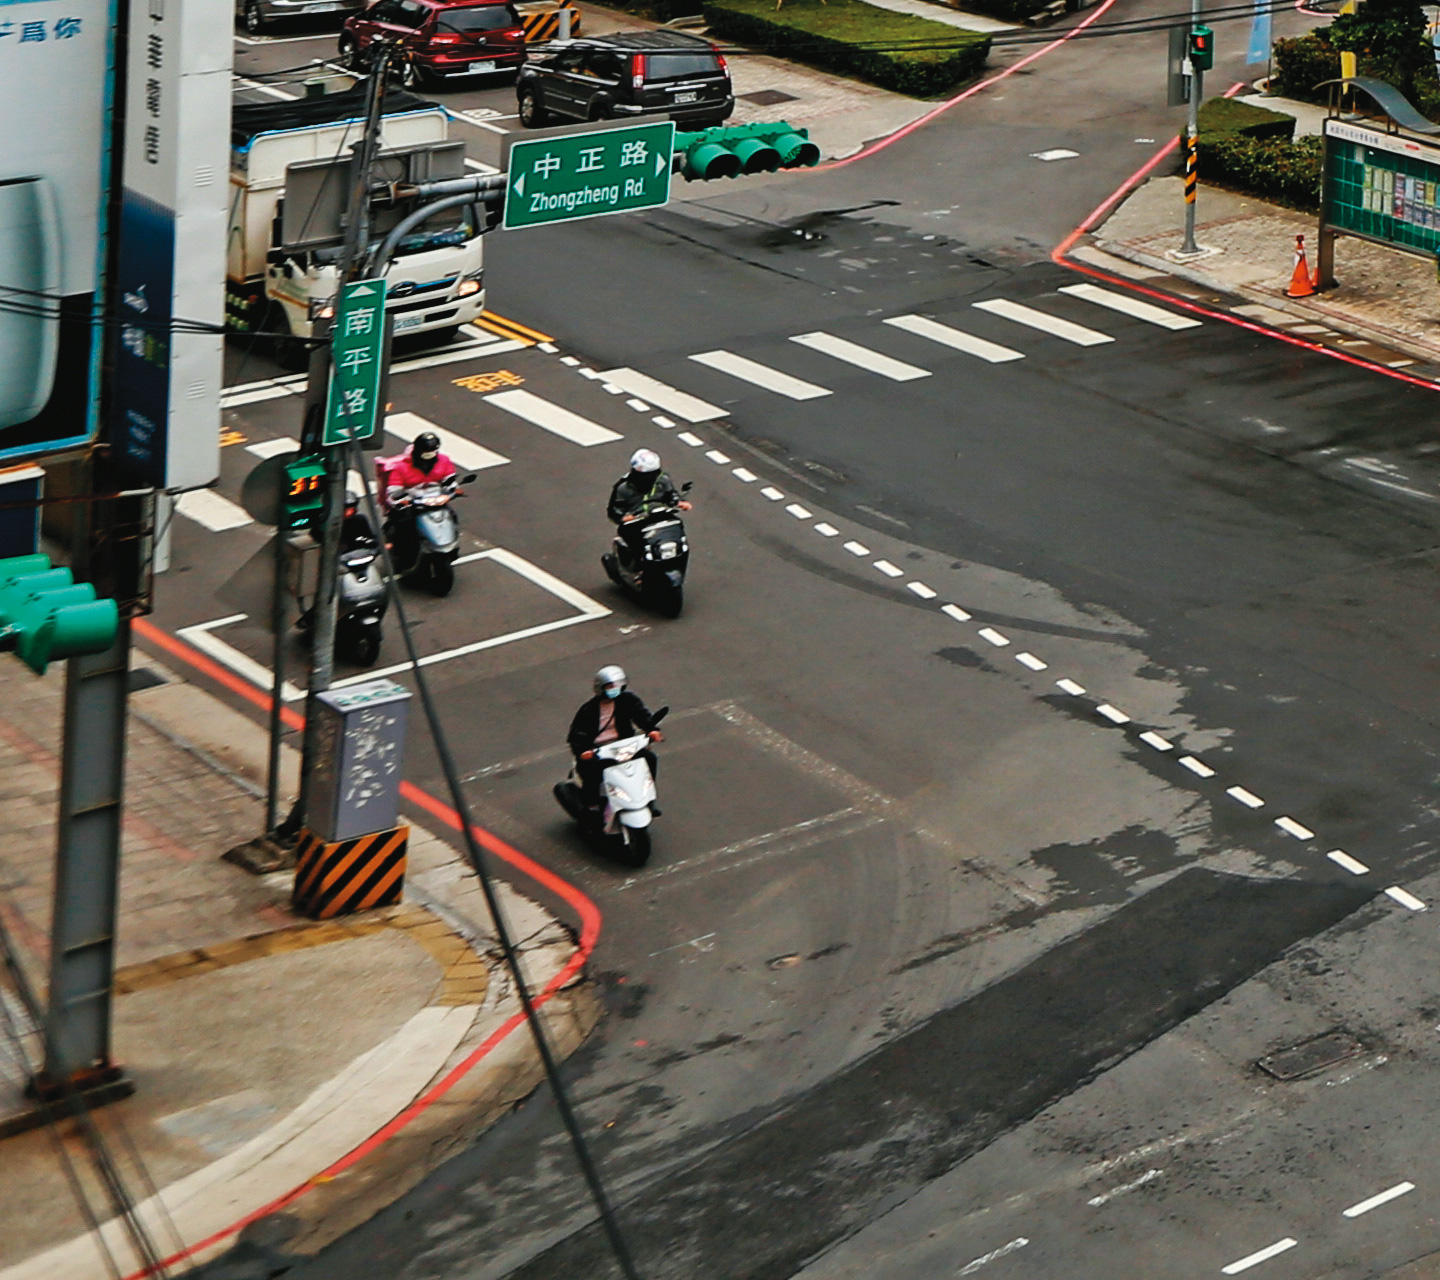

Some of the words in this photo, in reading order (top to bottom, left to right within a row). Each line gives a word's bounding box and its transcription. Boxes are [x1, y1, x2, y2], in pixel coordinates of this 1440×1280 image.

[532, 140, 649, 180] 中正路
[529, 184, 619, 213] Zhongzheng
[336, 306, 377, 418] 南平路
